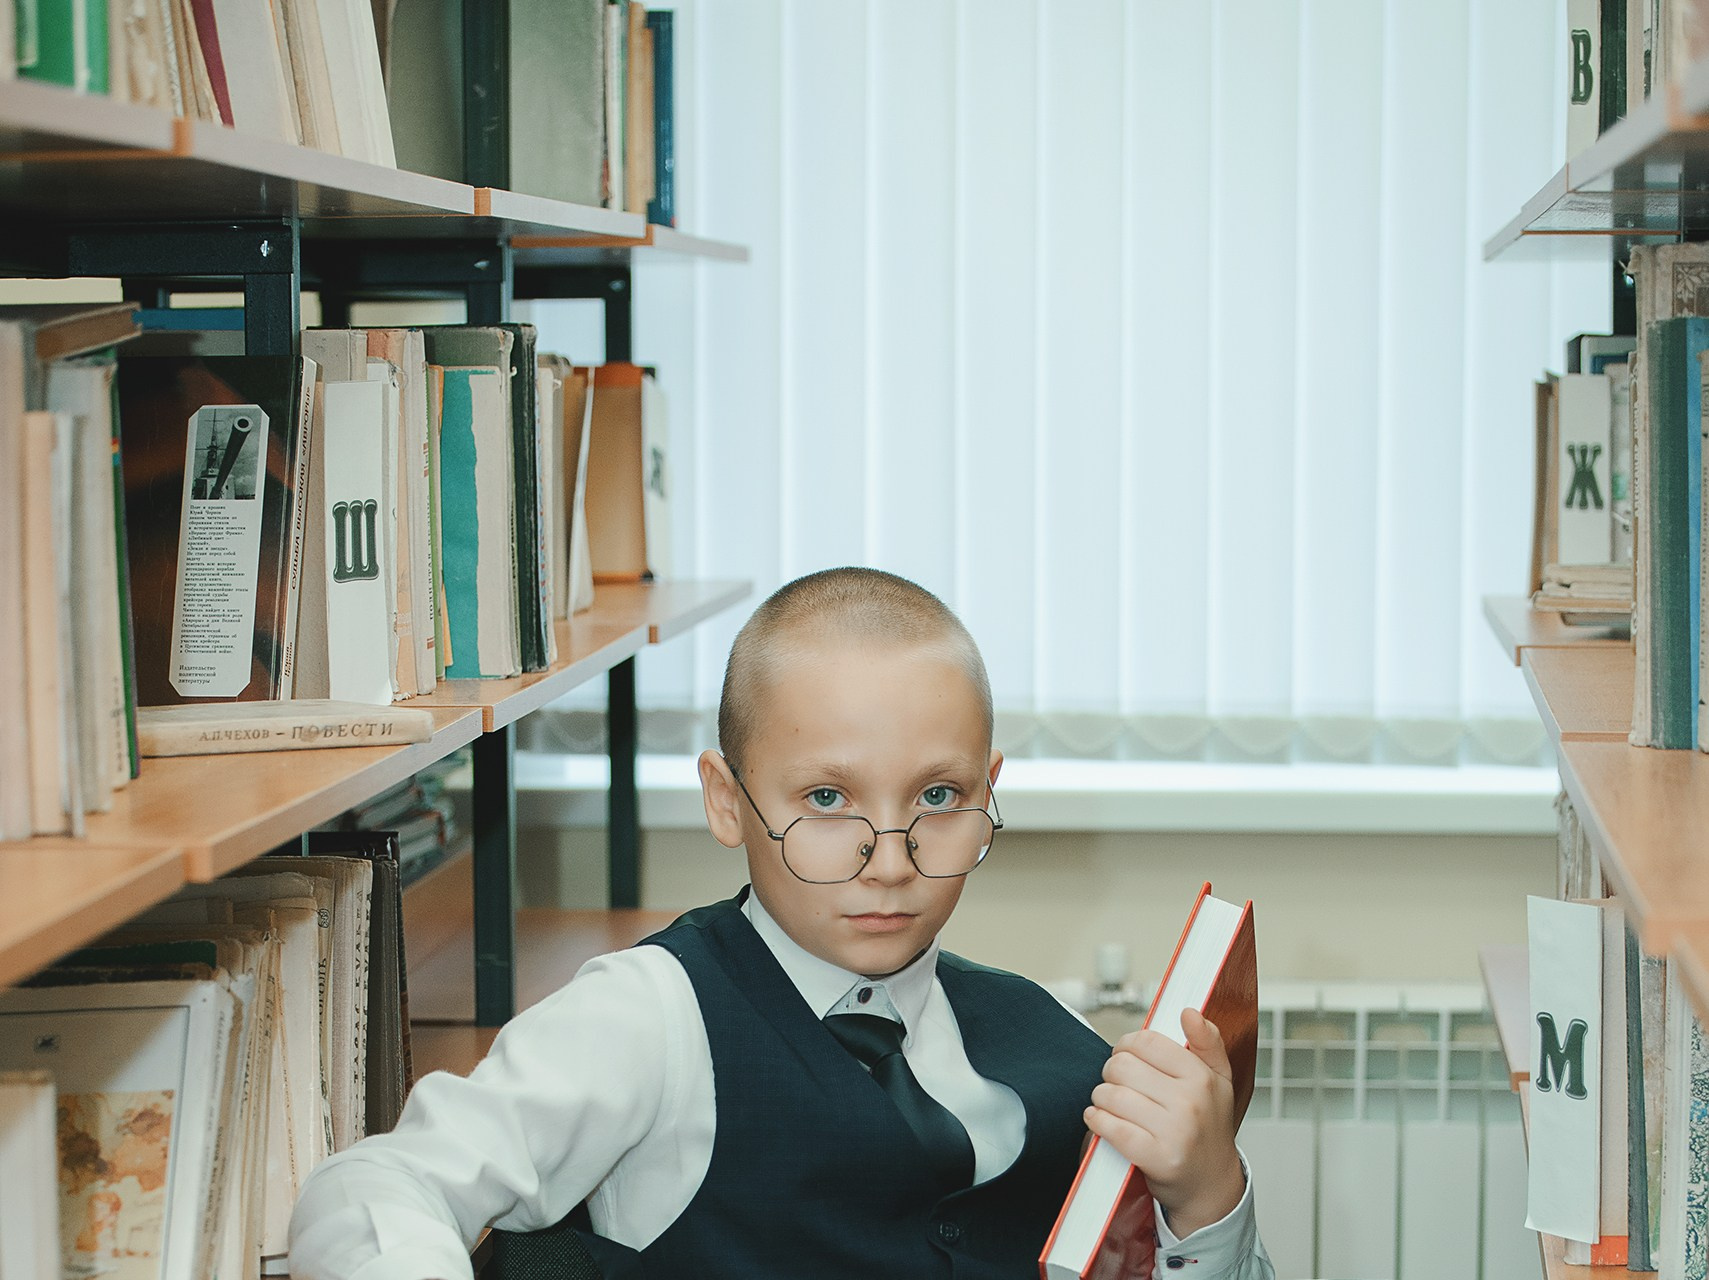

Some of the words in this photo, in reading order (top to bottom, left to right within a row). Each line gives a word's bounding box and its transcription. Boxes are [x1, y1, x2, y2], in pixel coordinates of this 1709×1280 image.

[1571, 29, 1593, 105] В
[291, 536, 300, 591] СУДЬБА
[296, 462, 306, 531] ВЫСОКАЯ
[301, 386, 311, 457] «АВРОРЫ»
[1565, 442, 1604, 510] Ж
[333, 500, 379, 583] Ш
[291, 722, 394, 740] ПОВЕСТИ
[1536, 1011, 1588, 1100] М
